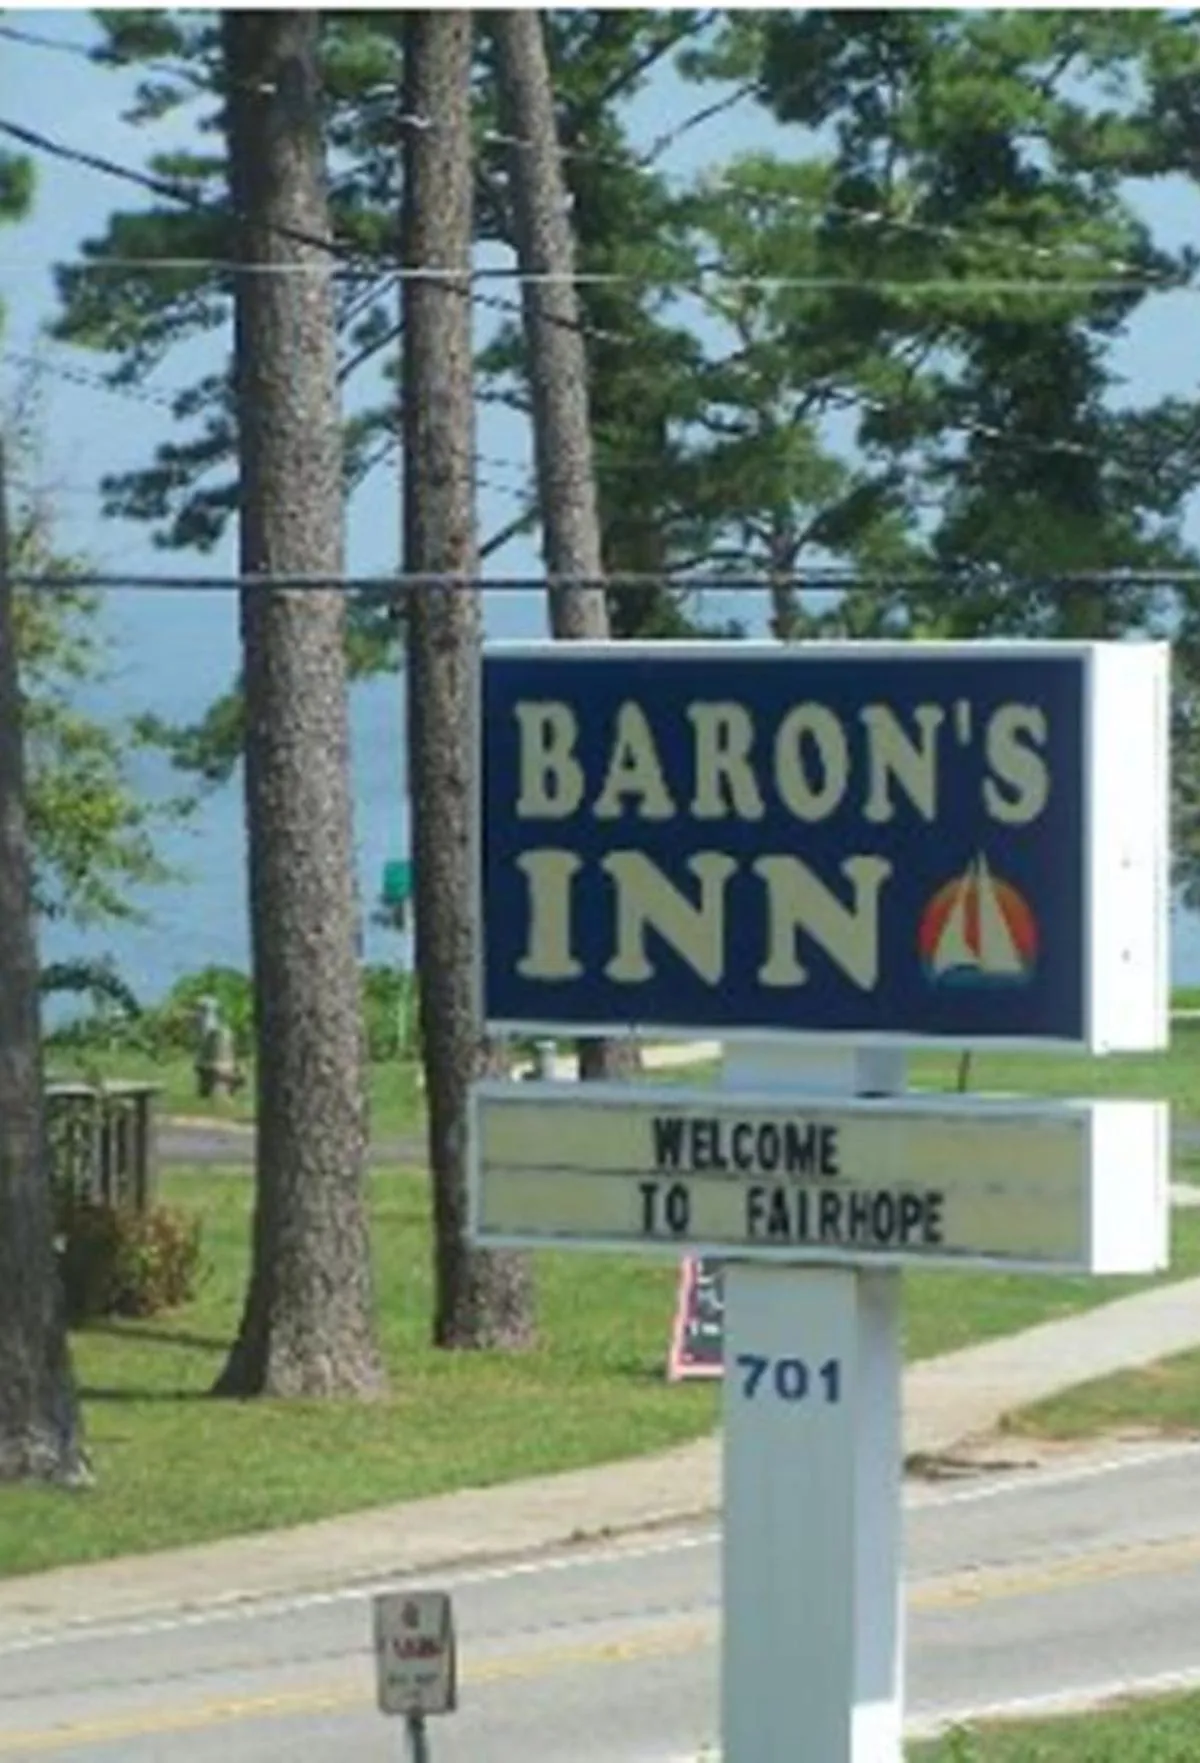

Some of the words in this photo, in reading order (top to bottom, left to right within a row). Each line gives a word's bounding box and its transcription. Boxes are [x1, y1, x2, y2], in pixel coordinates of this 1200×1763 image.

[514, 698, 1050, 824] BARON'S
[515, 848, 892, 992] INN
[652, 1116, 839, 1175] WELCOME
[638, 1183, 691, 1233] TO
[745, 1187, 944, 1244] FAIRHOPE
[736, 1355, 841, 1402] 701
